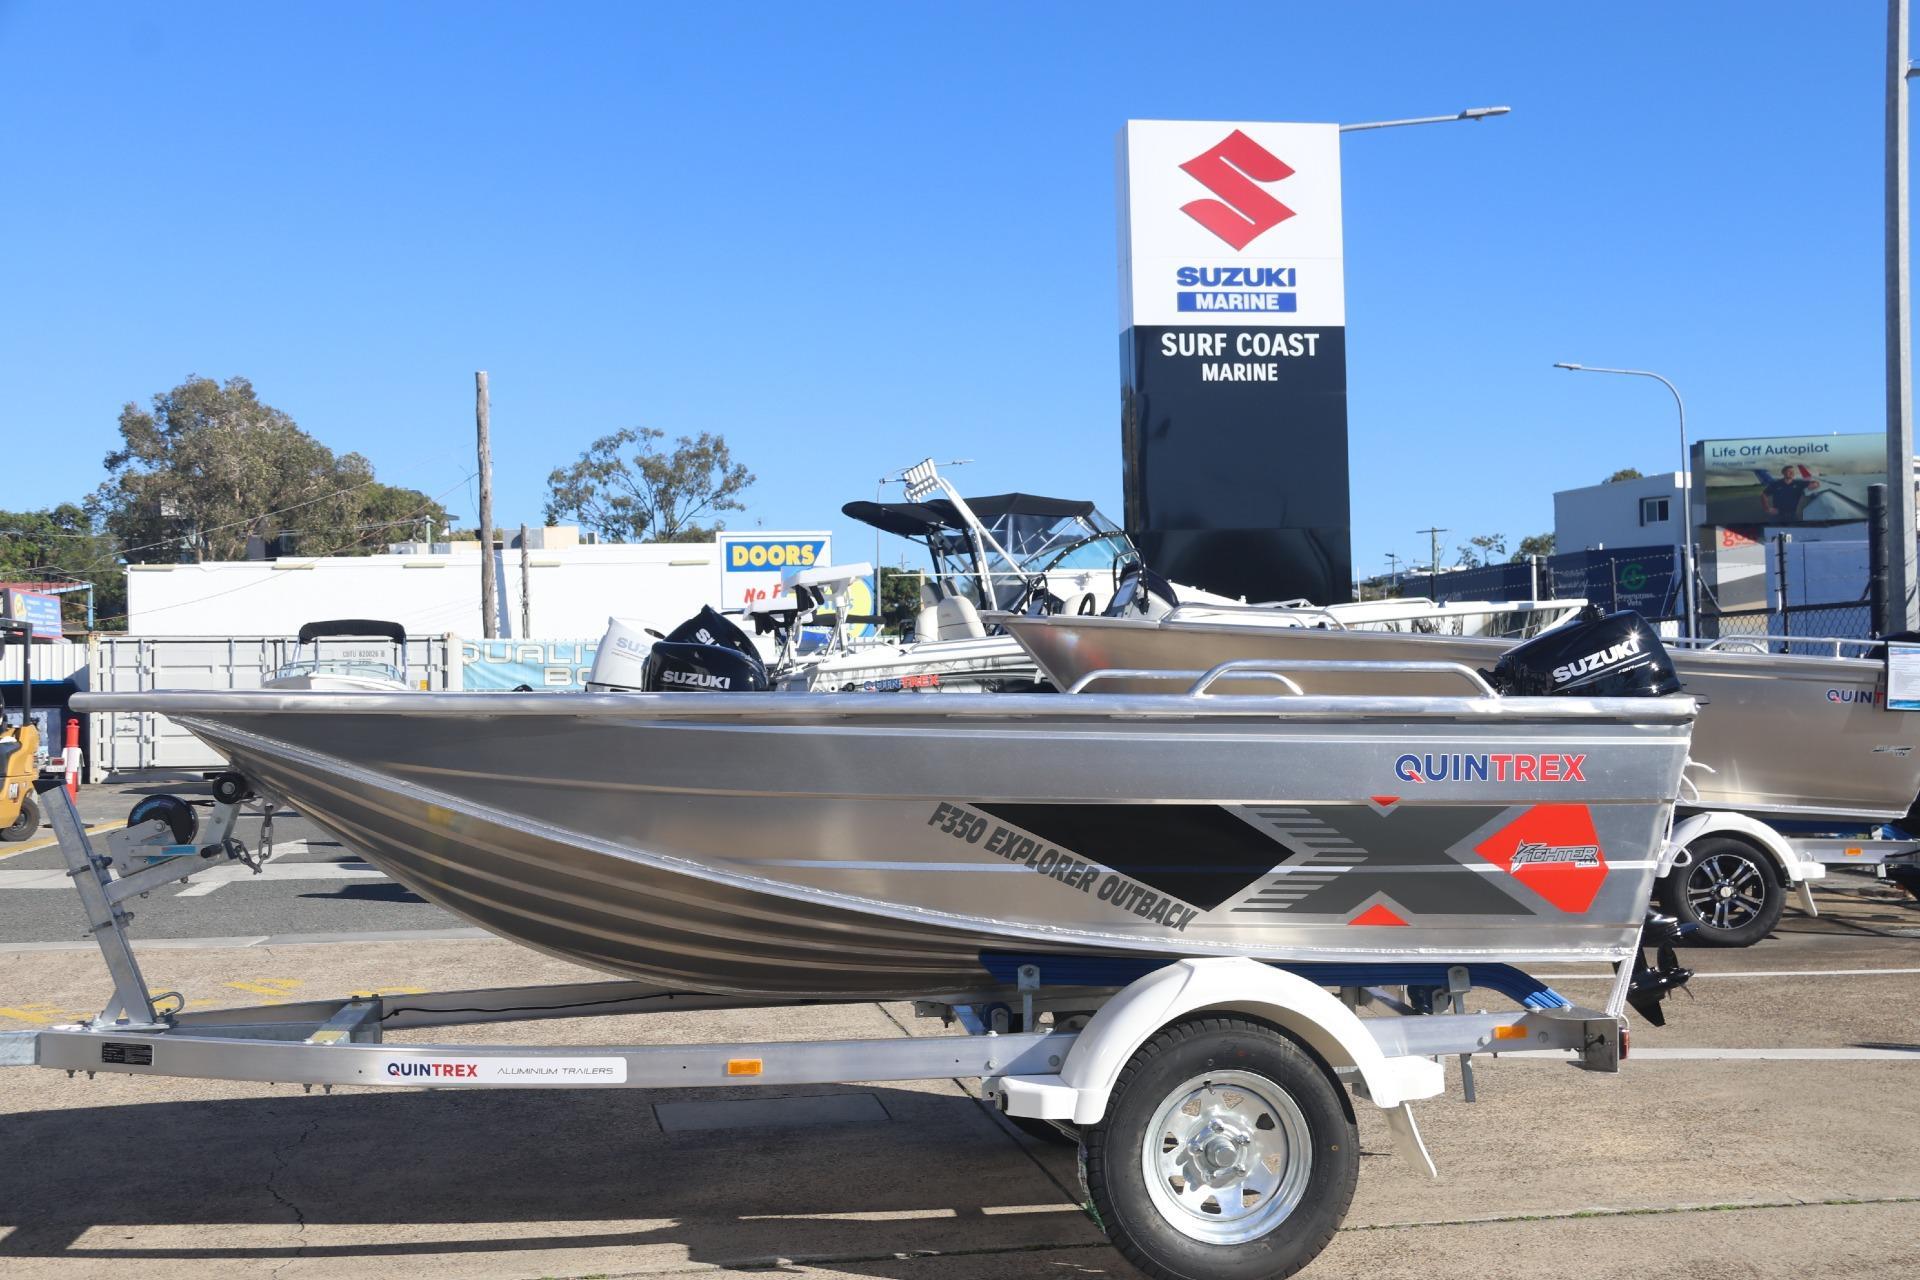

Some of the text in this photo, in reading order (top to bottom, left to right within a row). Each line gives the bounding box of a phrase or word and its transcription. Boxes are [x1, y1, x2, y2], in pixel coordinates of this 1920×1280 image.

[1177, 267, 1296, 287] SUZUKI
[1196, 293, 1279, 310] MARINE
[1161, 332, 1319, 357] SURF COAST
[1202, 363, 1278, 381] MARINE
[1712, 442, 1829, 457] Life Off Autopilot
[732, 545, 815, 566] DOORS
[1552, 638, 1640, 683] SUZUKI
[662, 670, 731, 690] SUZUKI
[864, 675, 939, 692] QUINTREX
[1826, 689, 1884, 704] QUINT
[1395, 753, 1587, 783] QUINTREX
[928, 801, 1199, 932] F350 EXPLORER OUTBACK
[387, 1062, 614, 1078] QUINTREX ALUMINIUM TRAILERS
